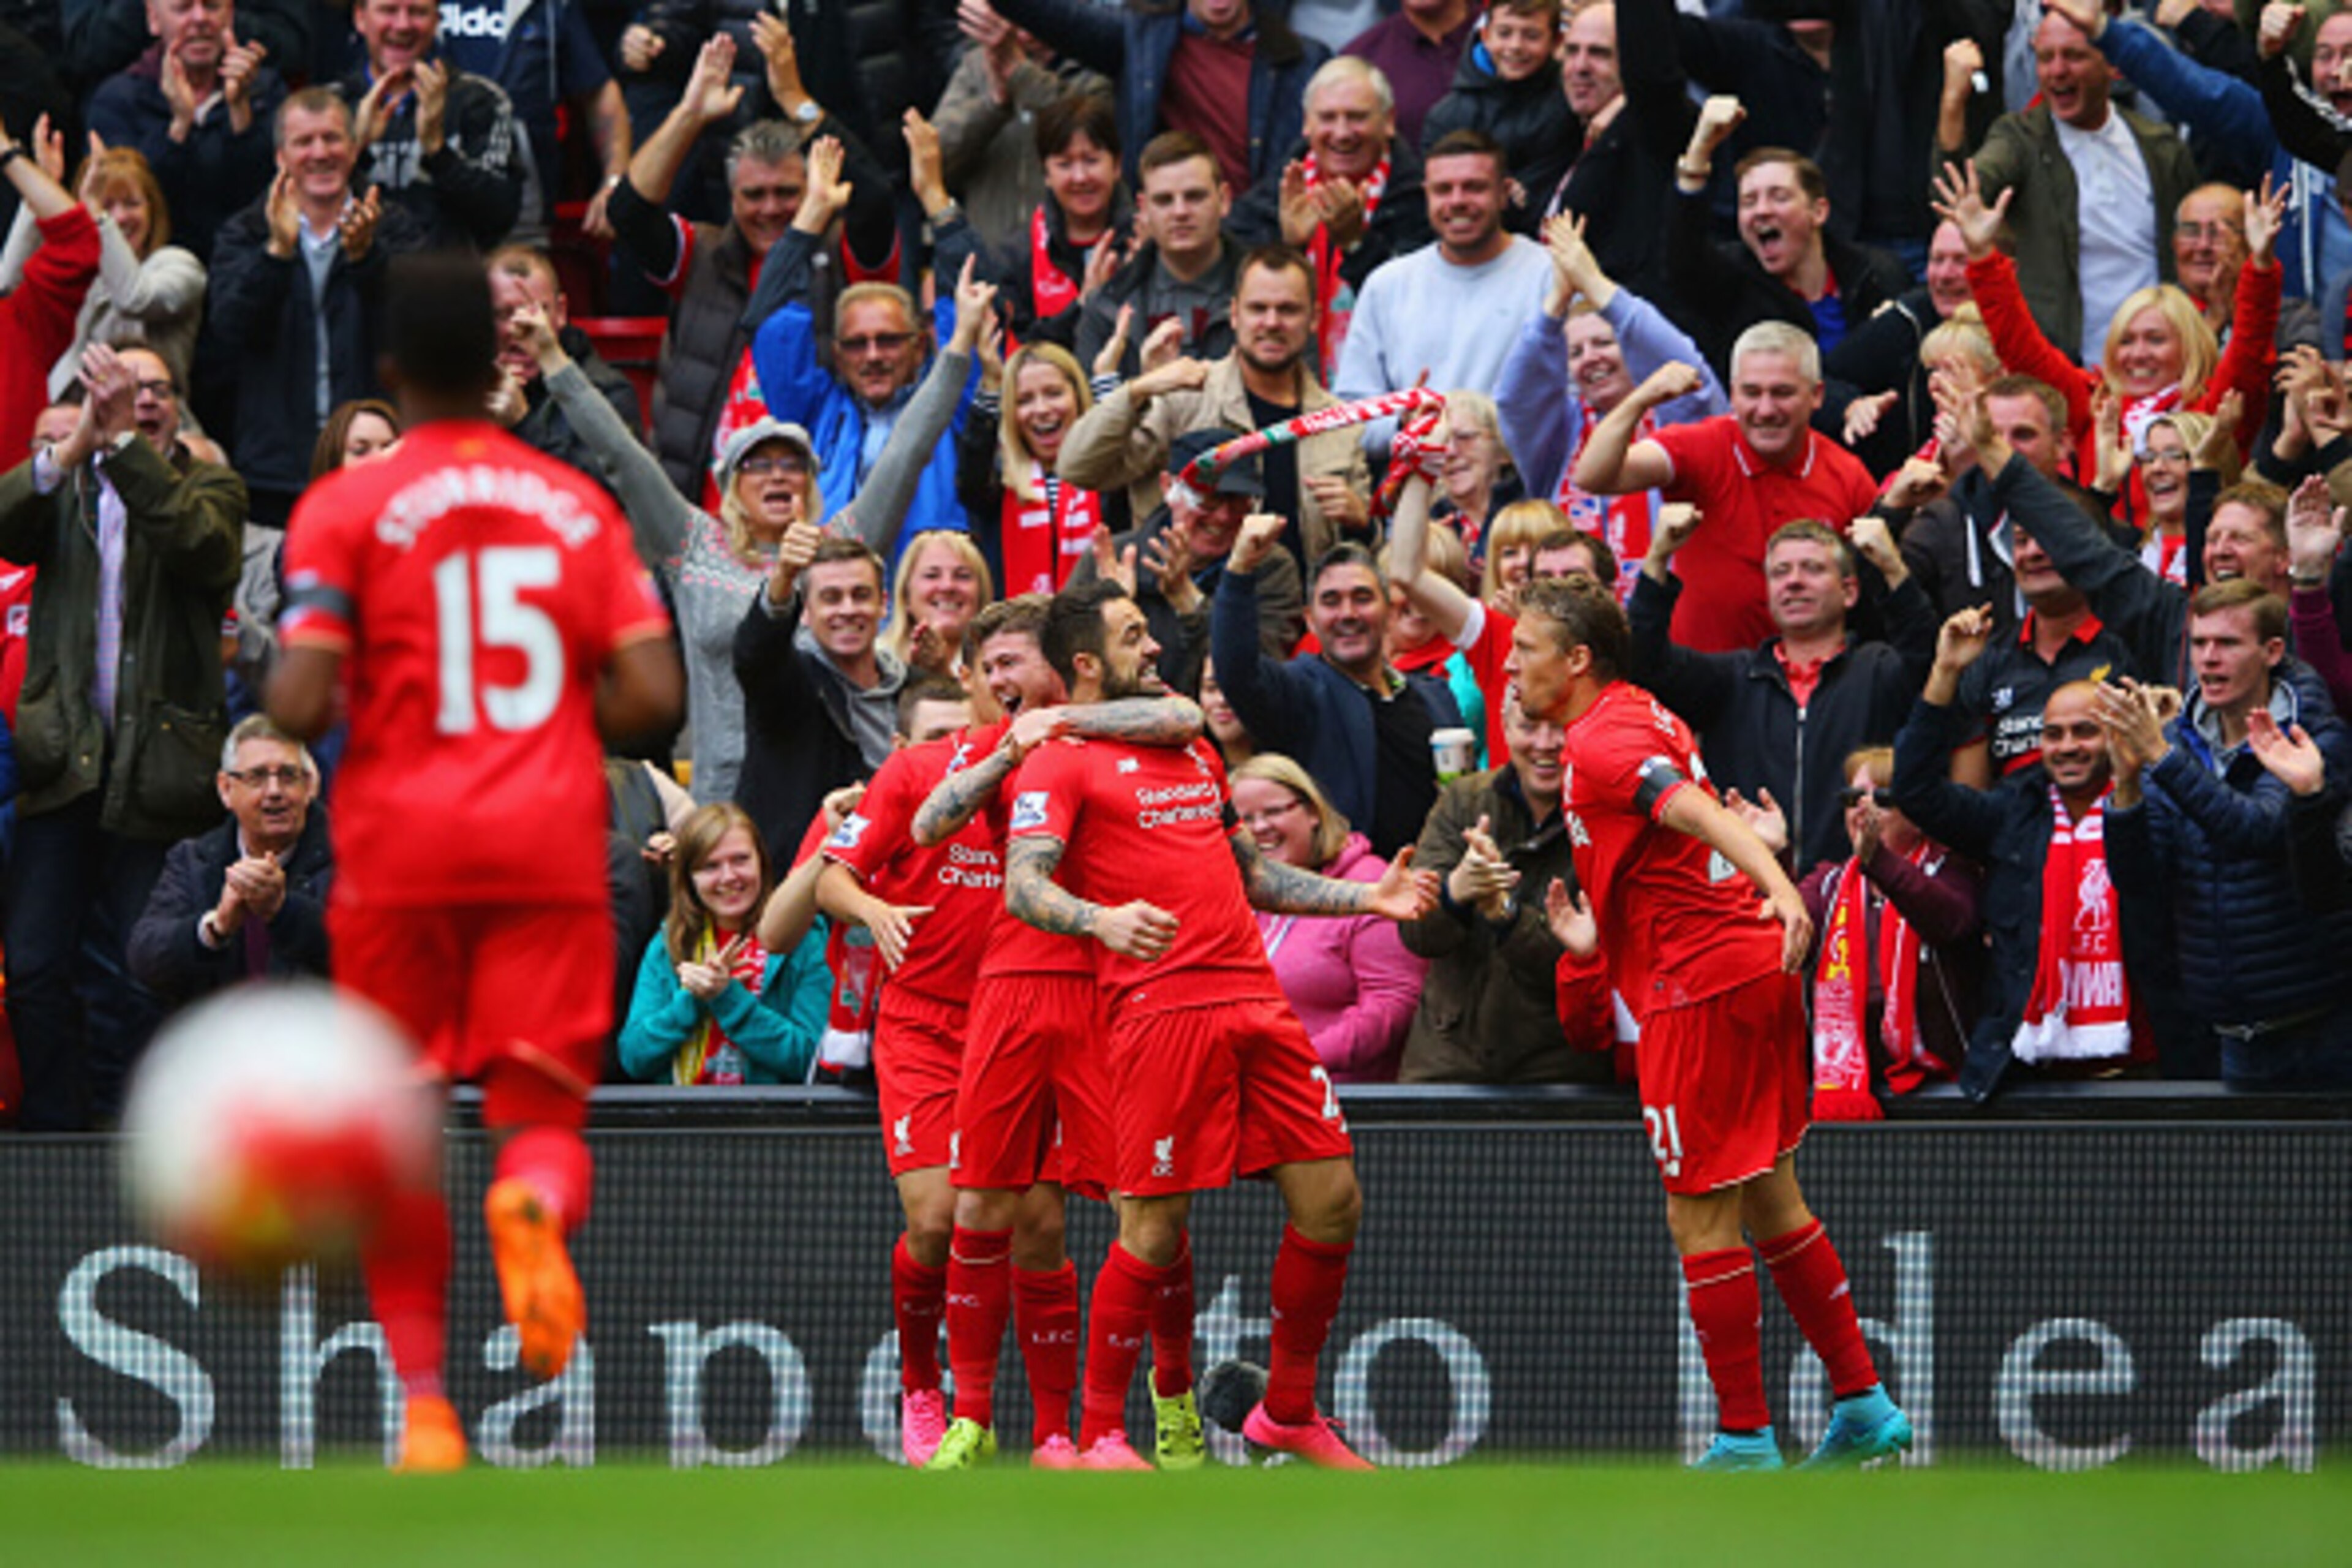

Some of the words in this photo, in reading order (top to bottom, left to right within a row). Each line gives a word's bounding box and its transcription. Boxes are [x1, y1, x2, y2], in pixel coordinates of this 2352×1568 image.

[434, 545, 564, 733] 15
[1642, 1104, 1683, 1161] 21
[1678, 1230, 2315, 1472] Idea
